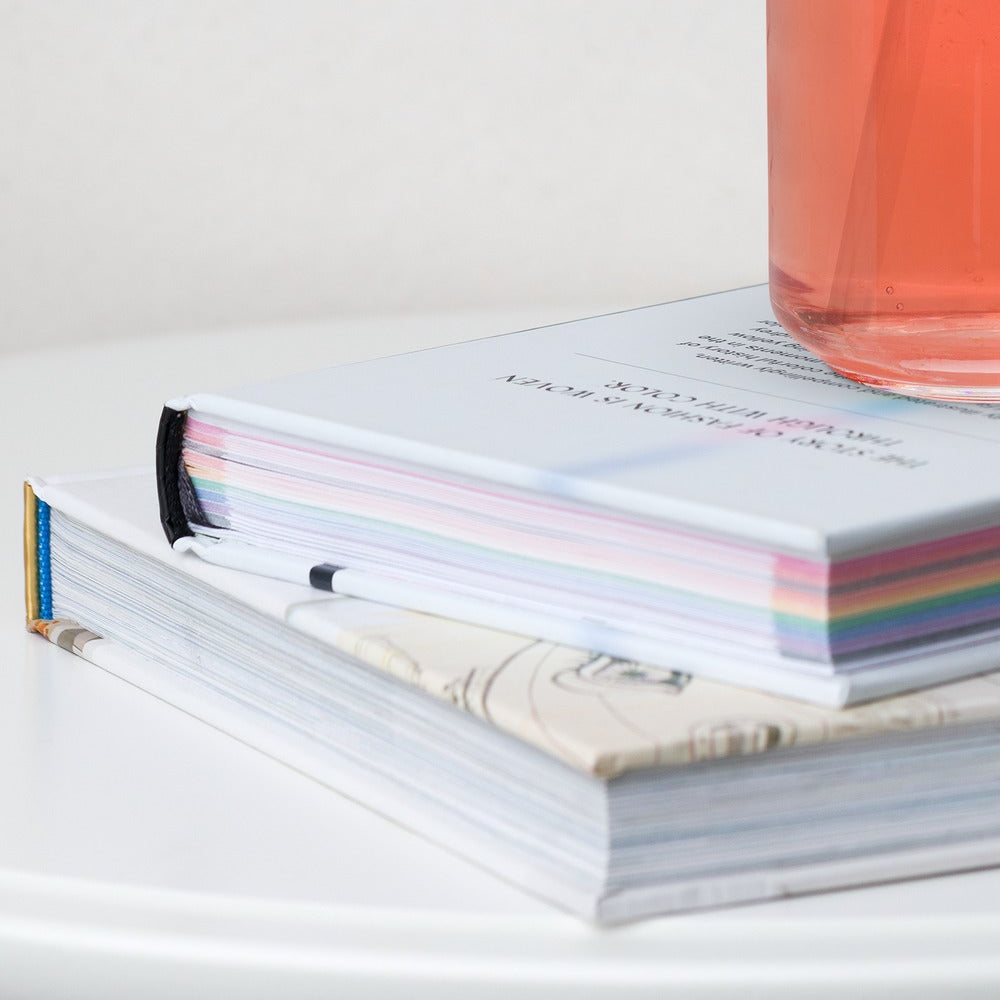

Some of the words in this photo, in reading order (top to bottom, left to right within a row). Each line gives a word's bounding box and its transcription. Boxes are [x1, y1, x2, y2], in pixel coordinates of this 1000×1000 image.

[698, 335, 727, 344] the
[728, 332, 782, 346] yellow
[750, 326, 792, 338] udrey
[700, 345, 761, 362] history
[745, 345, 824, 364] moments
[757, 357, 823, 375] colorful
[494, 374, 595, 399] WOVEN
[754, 367, 857, 390] compellingly
[594, 396, 629, 405] IS
[623, 402, 743, 429] FASHION
[694, 401, 768, 419] WITH
[737, 427, 785, 437] OF
[768, 416, 903, 447] THROUGH
[788, 437, 875, 455] STORY
